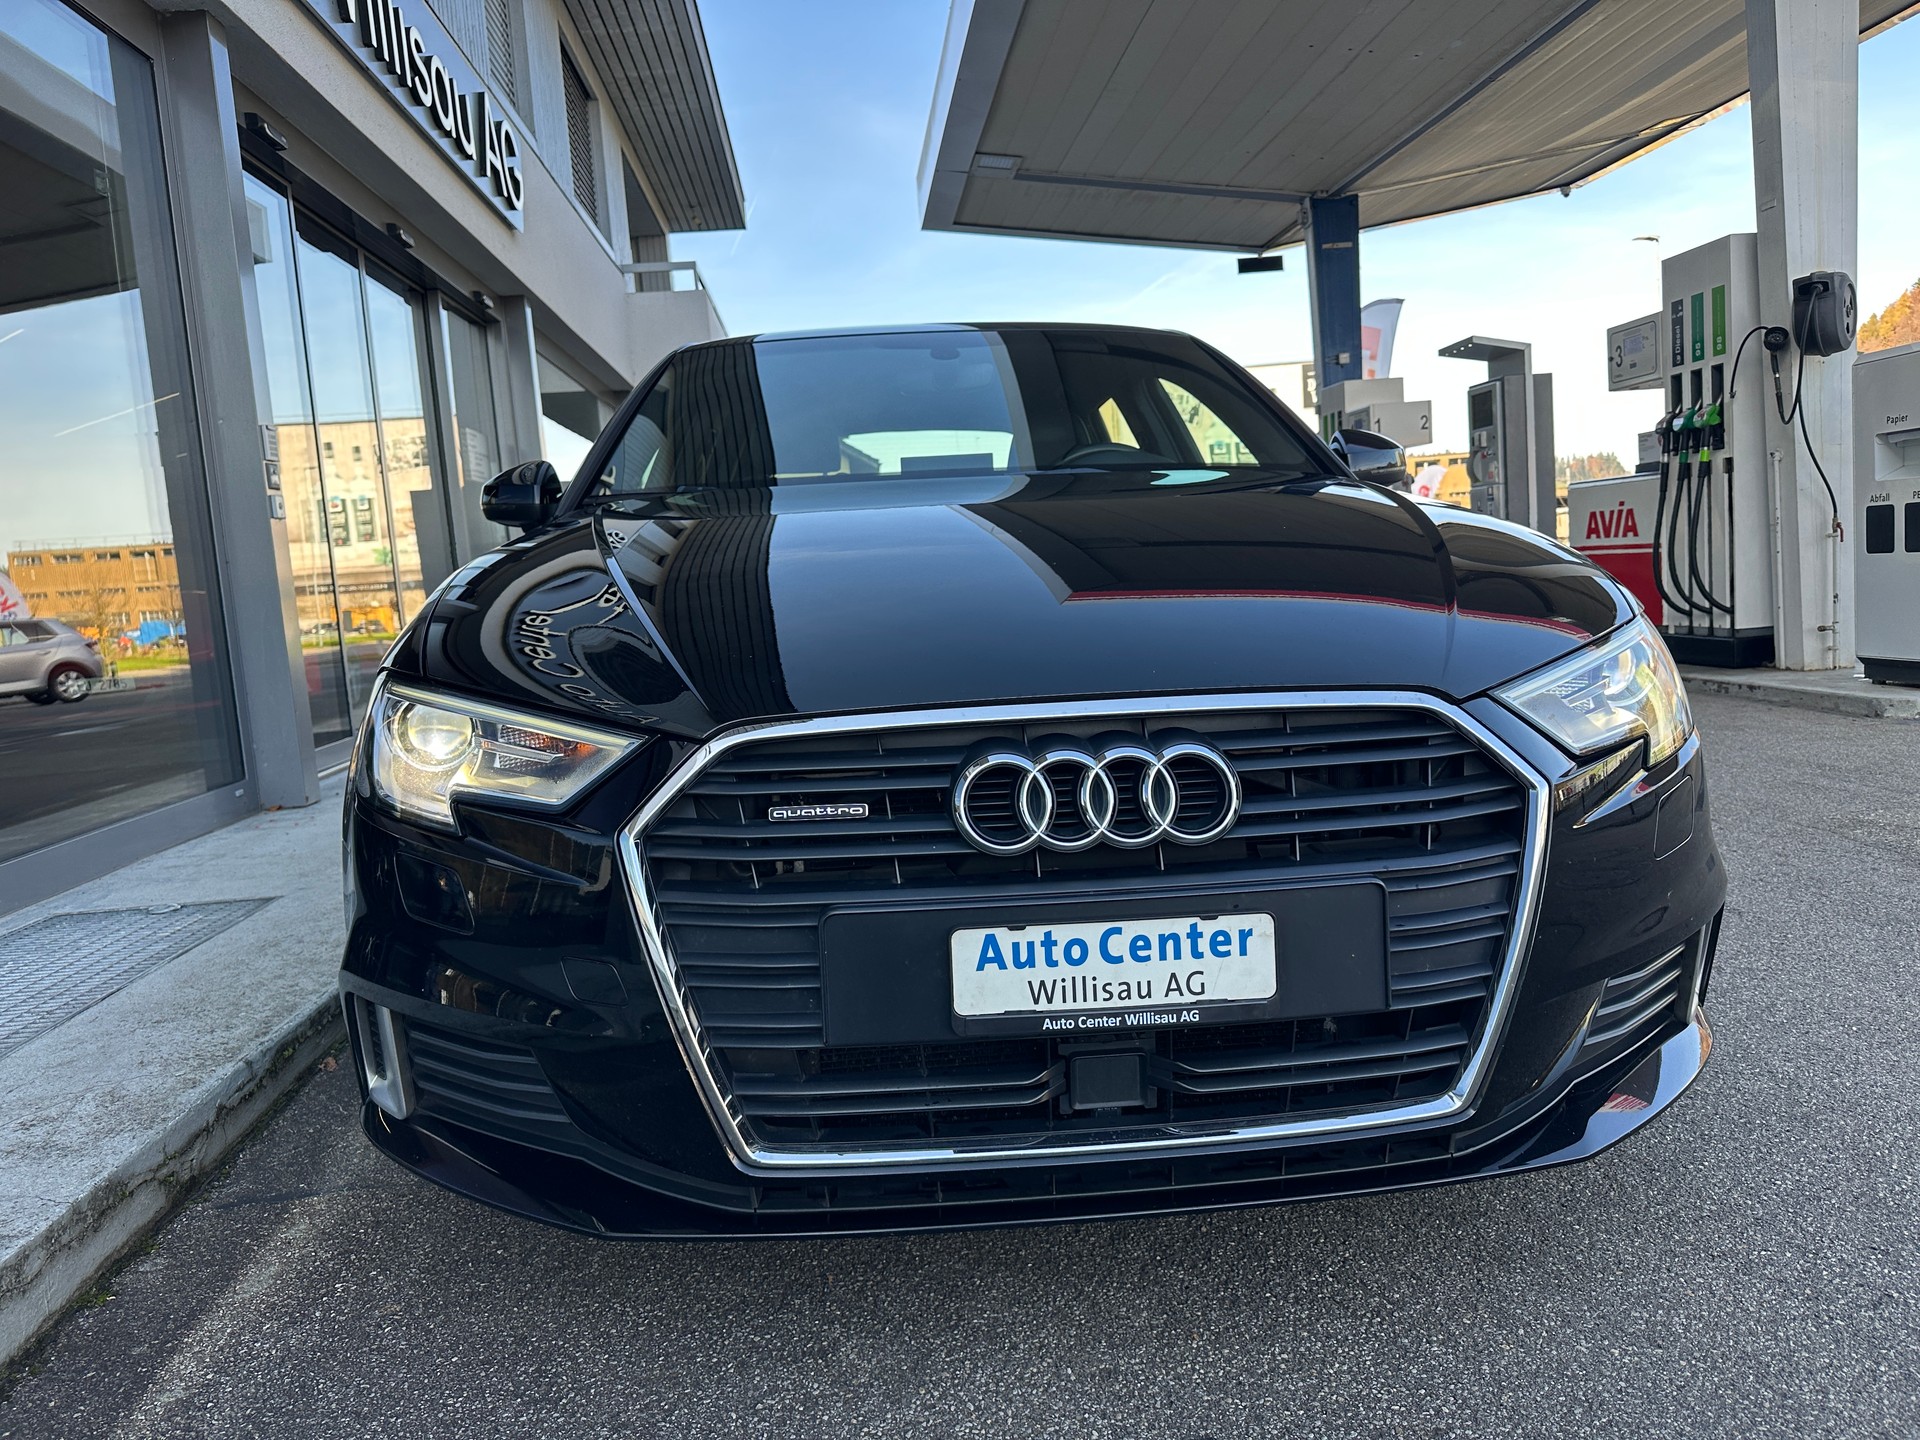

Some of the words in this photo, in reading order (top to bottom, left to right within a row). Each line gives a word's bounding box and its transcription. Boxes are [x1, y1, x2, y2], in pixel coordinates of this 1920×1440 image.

[338, 0, 477, 161] llisau
[478, 91, 524, 211] AG
[1615, 345, 1623, 368] 3
[1374, 418, 1381, 433] 1
[1420, 415, 1429, 430] 2
[1886, 414, 1908, 425] Papier
[1869, 493, 1890, 503] Abfall
[773, 807, 864, 819] quattro
[976, 930, 1089, 972] Auto
[1099, 922, 1254, 965] Center
[1027, 975, 1152, 1005] Willisau
[1164, 971, 1206, 998] AG
[1042, 1017, 1075, 1031] Auto
[1078, 1014, 1122, 1028] Center
[1125, 1011, 1177, 1026] Willisau
[1180, 1010, 1200, 1023] AG
